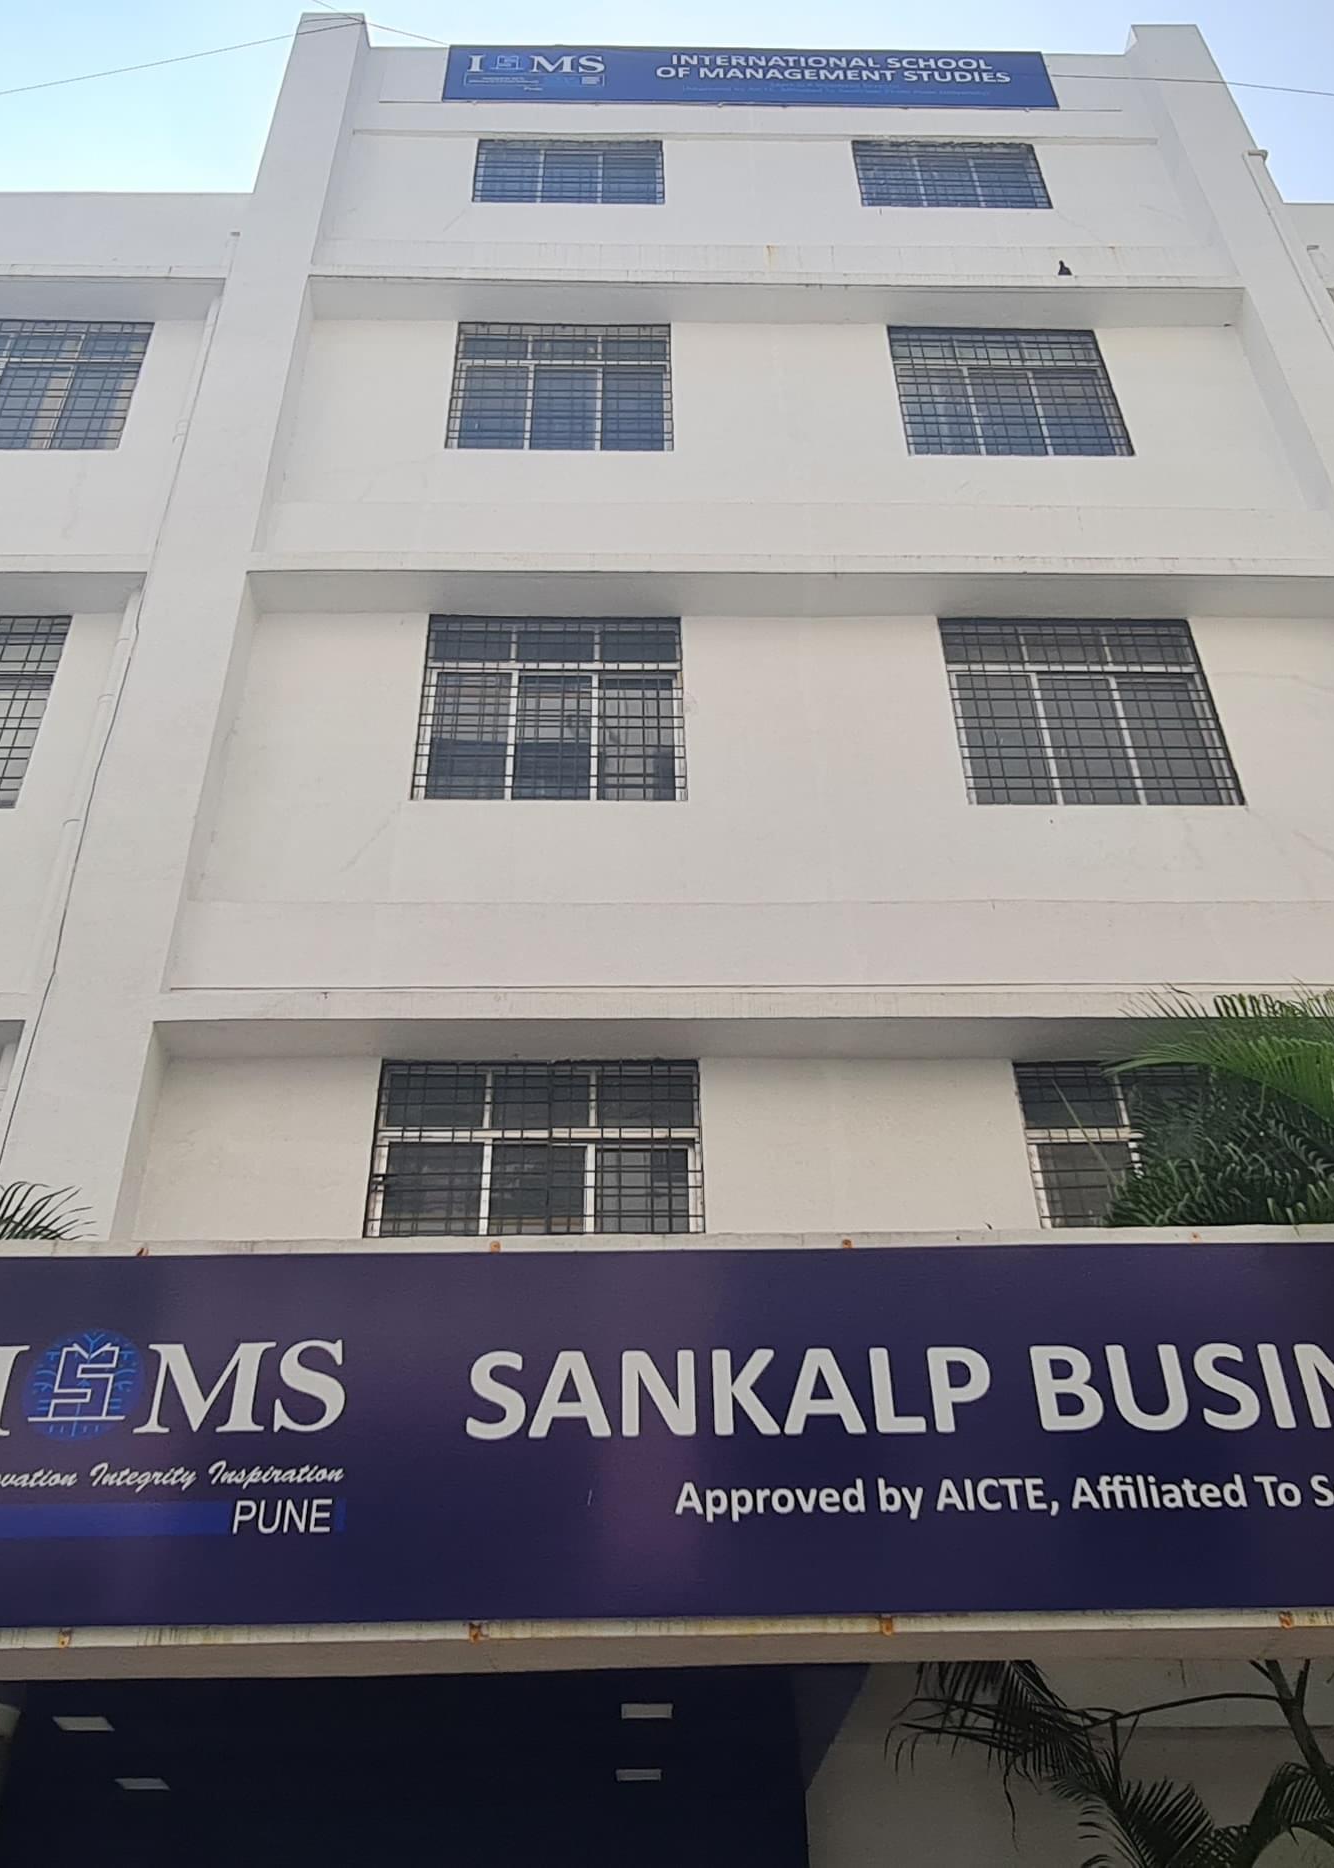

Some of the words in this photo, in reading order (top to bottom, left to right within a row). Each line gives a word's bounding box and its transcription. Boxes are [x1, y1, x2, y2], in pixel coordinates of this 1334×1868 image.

[656, 66, 691, 78] OF
[699, 67, 896, 81] MANAGEMENT
[903, 70, 1011, 83] STUDIES
[671, 54, 881, 69] INTERNATIONAL
[887, 57, 993, 70] SCHOOL
[465, 1346, 992, 1440] SANKALP
[89, 1461, 196, 1493] Integrity
[208, 1459, 344, 1492] Inspiration
[675, 1478, 866, 1523] Approved
[877, 1477, 924, 1520] by
[936, 1477, 1059, 1516] AICTE,
[1071, 1473, 1248, 1510] Affiliated
[1253, 1475, 1302, 1507] To
[231, 1498, 333, 1534] PUNE
